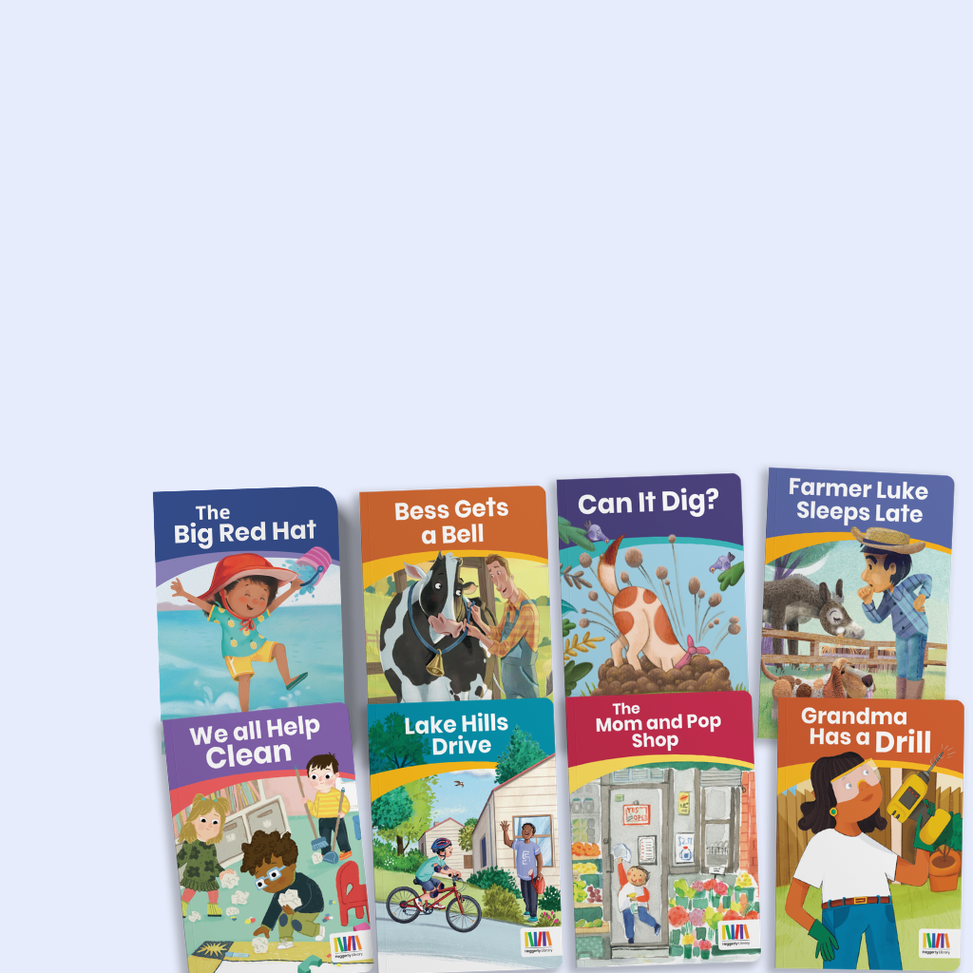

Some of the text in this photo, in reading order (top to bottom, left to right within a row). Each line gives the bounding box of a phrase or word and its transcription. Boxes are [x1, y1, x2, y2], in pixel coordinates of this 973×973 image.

[789, 477, 929, 501] Farmer Luke
[195, 504, 230, 521] The
[394, 496, 509, 521] Bess Gets
[578, 487, 719, 518] Can It Dig?
[796, 500, 923, 526] Sleeps Late
[174, 519, 317, 550] Big Red Hat
[421, 523, 484, 545] a Bell
[612, 702, 640, 715] The
[801, 707, 907, 725] Grandma
[189, 715, 321, 746] We all Help
[404, 712, 509, 735] Lake Hills
[596, 713, 722, 733] Mom and Pop
[432, 735, 492, 756] Drive
[632, 732, 679, 752] Shop
[810, 727, 931, 754] Has a Drill
[205, 743, 292, 769] Clean
